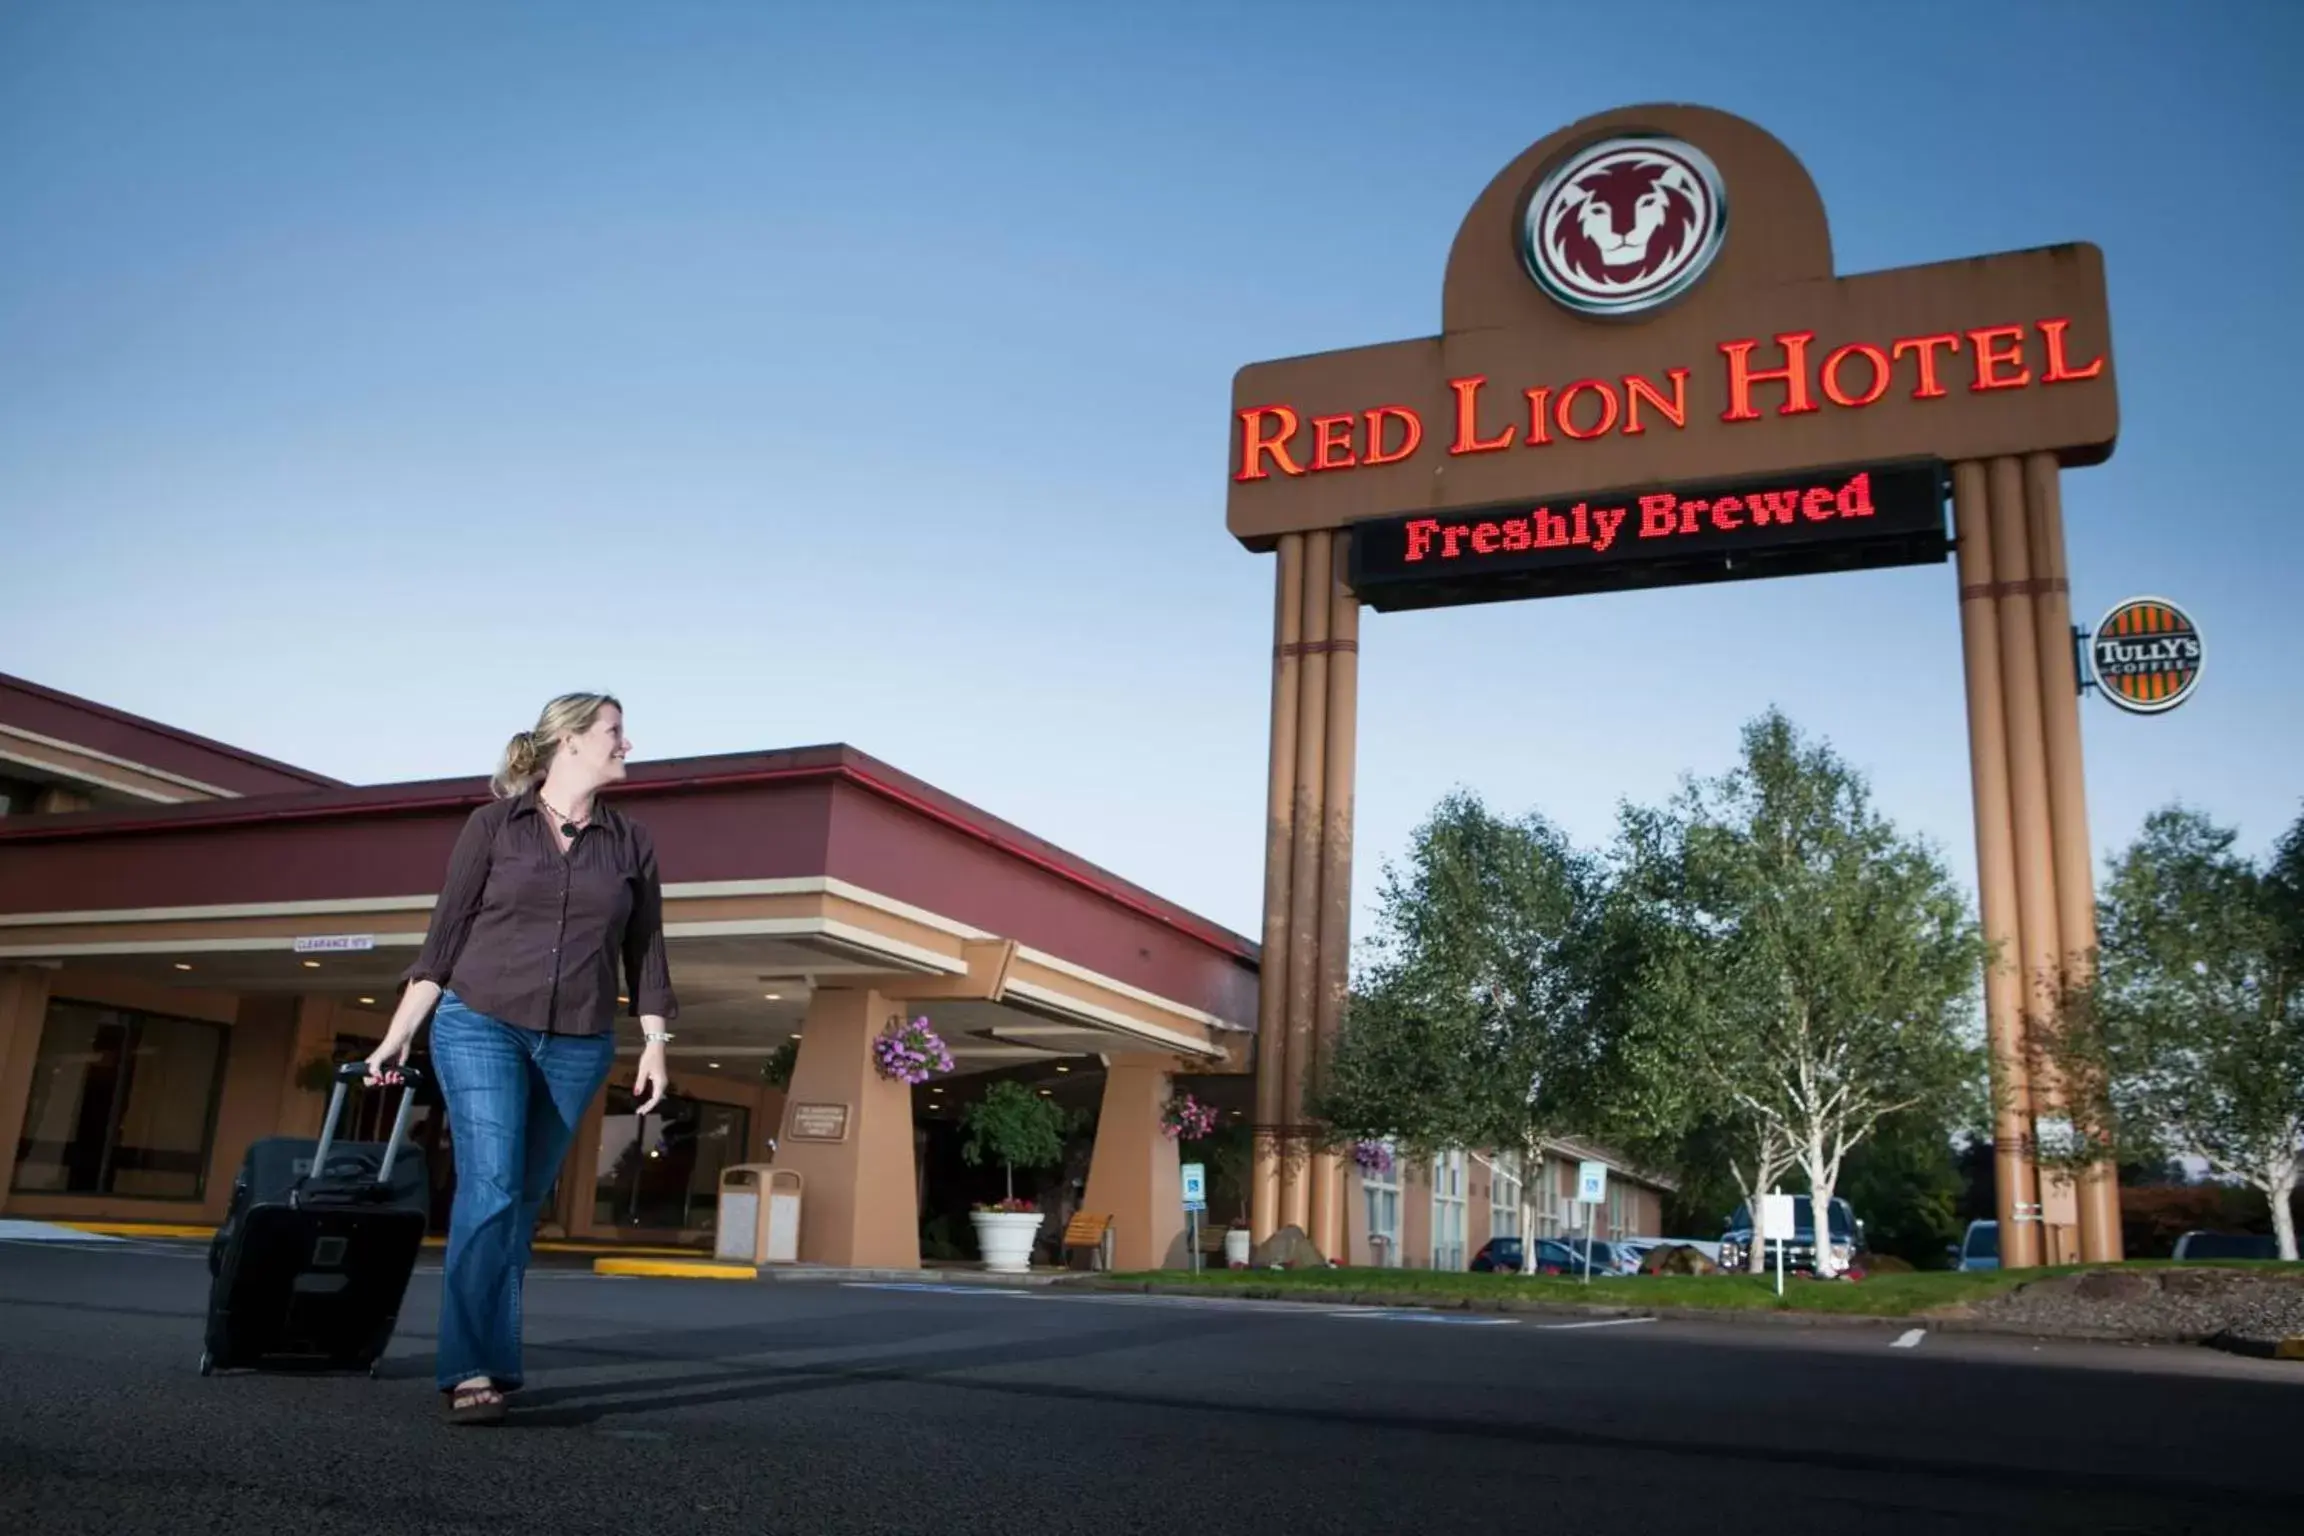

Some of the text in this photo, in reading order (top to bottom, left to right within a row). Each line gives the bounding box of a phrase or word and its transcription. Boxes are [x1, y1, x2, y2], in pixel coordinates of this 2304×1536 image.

[1233, 317, 2104, 482] RED LION HOTEL
[1404, 472, 1876, 562] Freshly Brewed
[2096, 637, 2200, 663] TULLY'S
[2110, 659, 2186, 674] COFFEE
